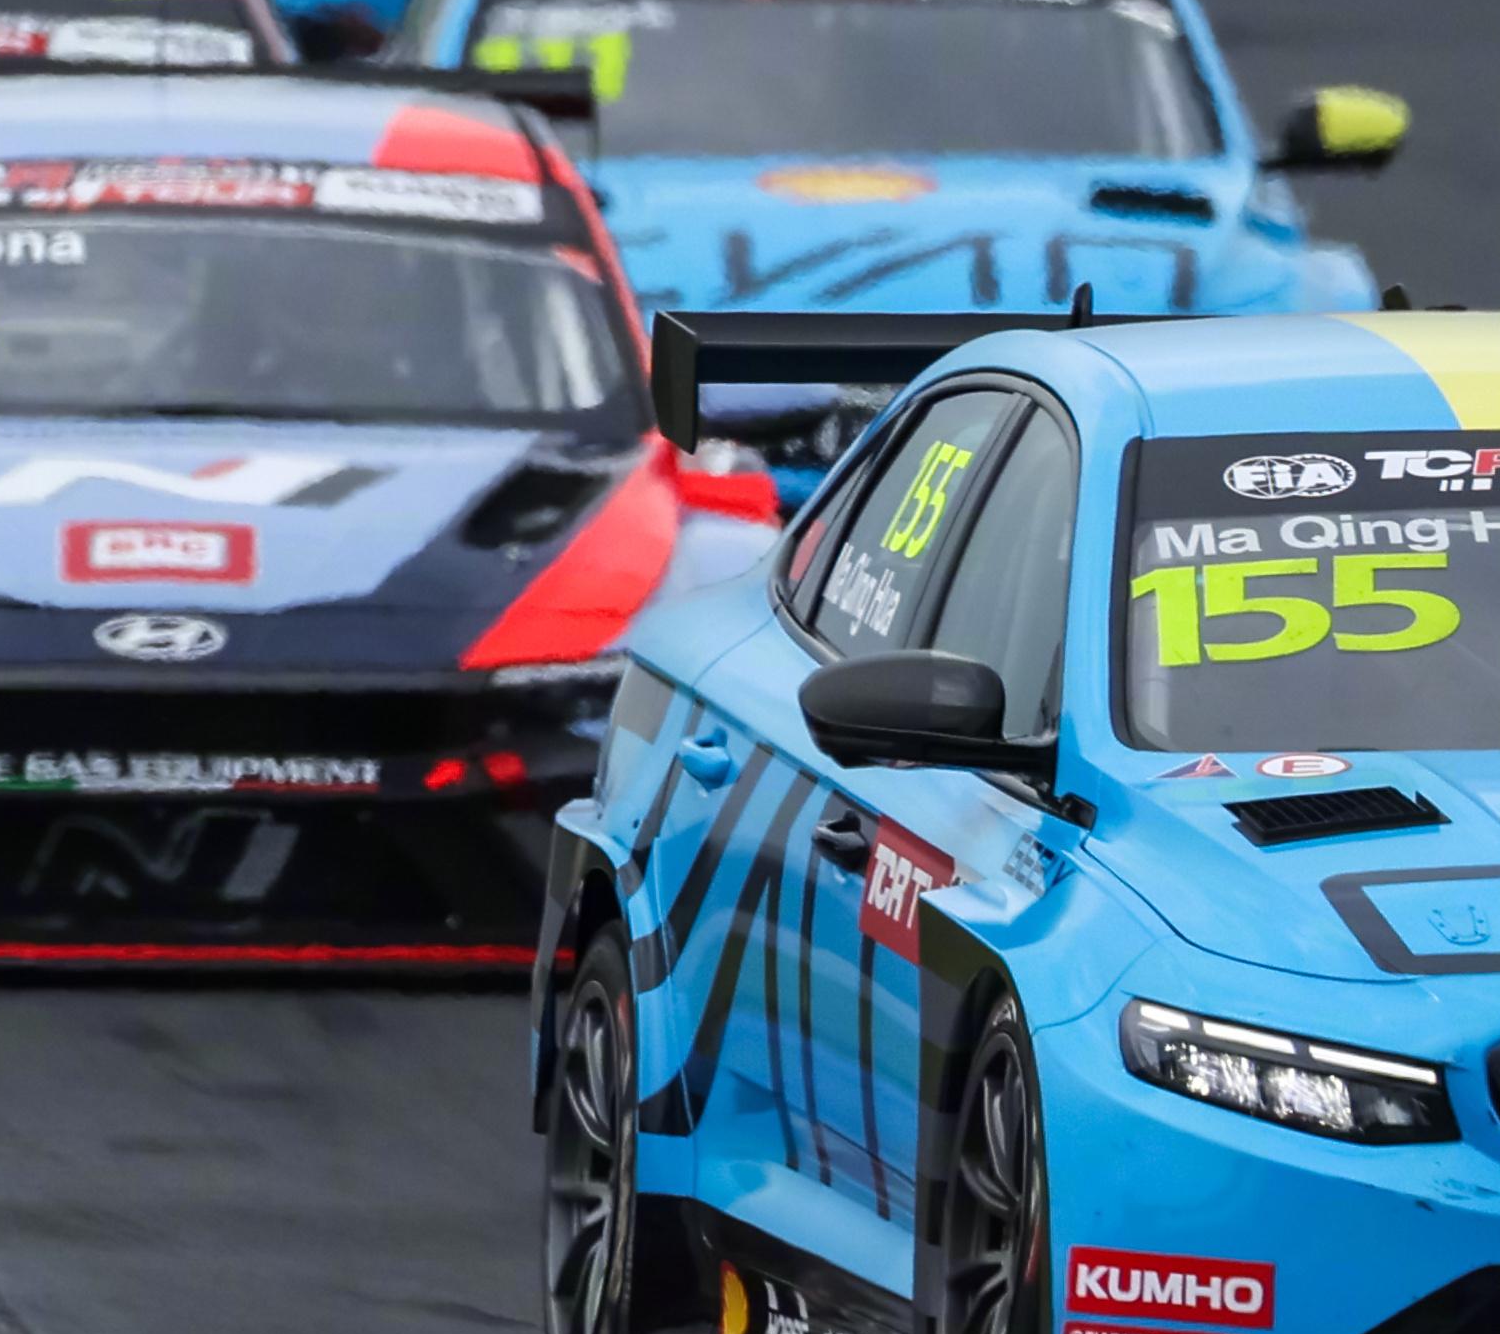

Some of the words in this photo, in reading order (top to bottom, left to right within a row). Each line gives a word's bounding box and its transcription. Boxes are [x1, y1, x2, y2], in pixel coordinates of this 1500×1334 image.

[1155, 522, 1262, 560] Ma
[1279, 514, 1449, 553] Qing
[1130, 552, 1461, 667] 155
[1074, 1262, 1264, 1316] KUMHO
